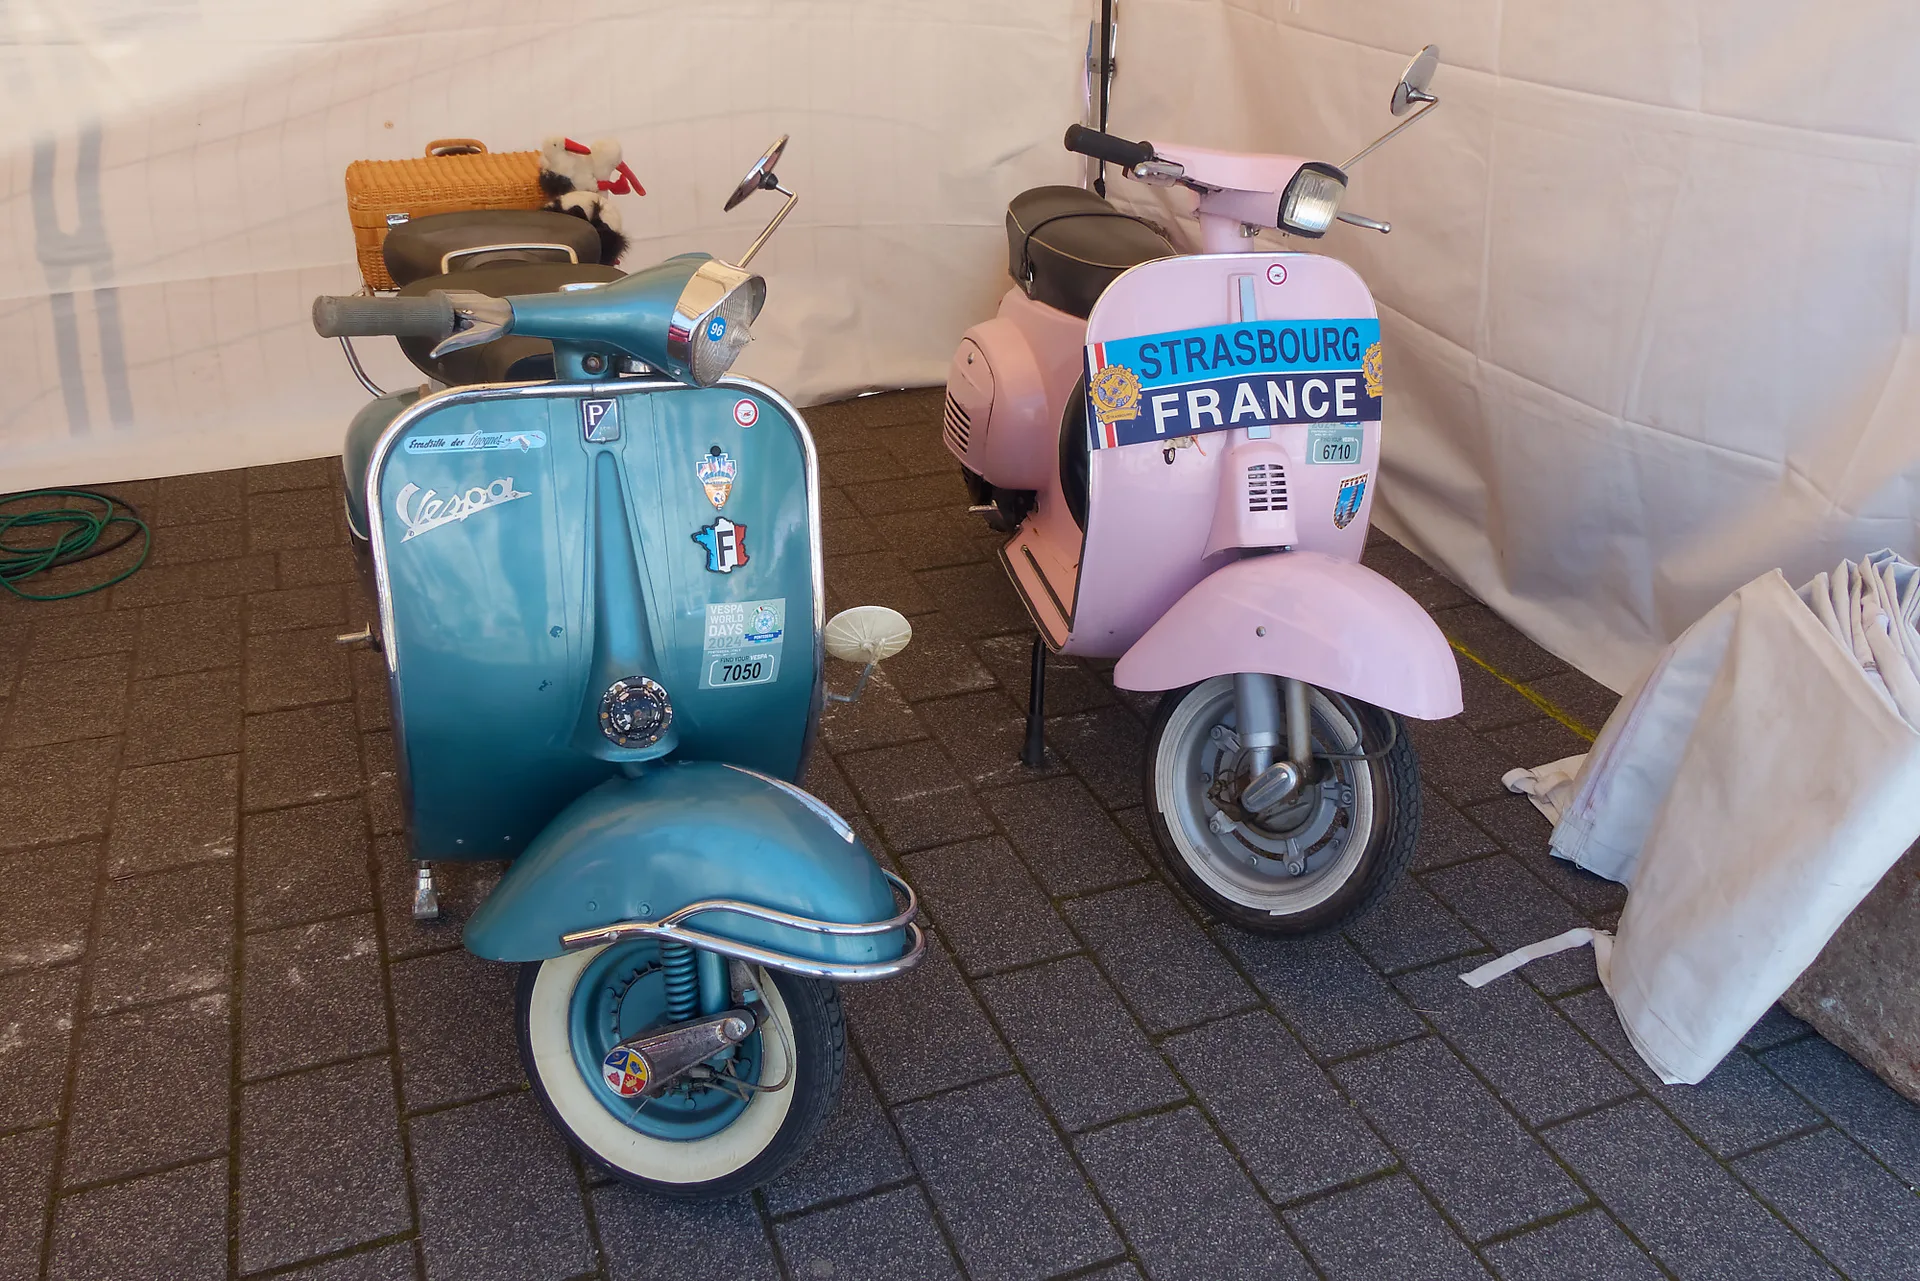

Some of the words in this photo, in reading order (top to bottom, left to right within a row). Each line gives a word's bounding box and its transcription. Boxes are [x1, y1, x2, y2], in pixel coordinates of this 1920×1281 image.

[710, 322, 724, 337] 96
[1139, 326, 1360, 379] STRASBOURG
[1151, 378, 1357, 434] FRANCE
[588, 404, 604, 426] P
[1323, 444, 1351, 460] 6710
[396, 477, 532, 543] Vespa
[717, 530, 733, 566] F
[709, 604, 744, 615] VESPA
[709, 614, 744, 625] WORLD
[708, 623, 744, 637] DAYS
[708, 636, 742, 649] 2024
[750, 653, 768, 661] VESPA
[723, 661, 762, 682] 7050
